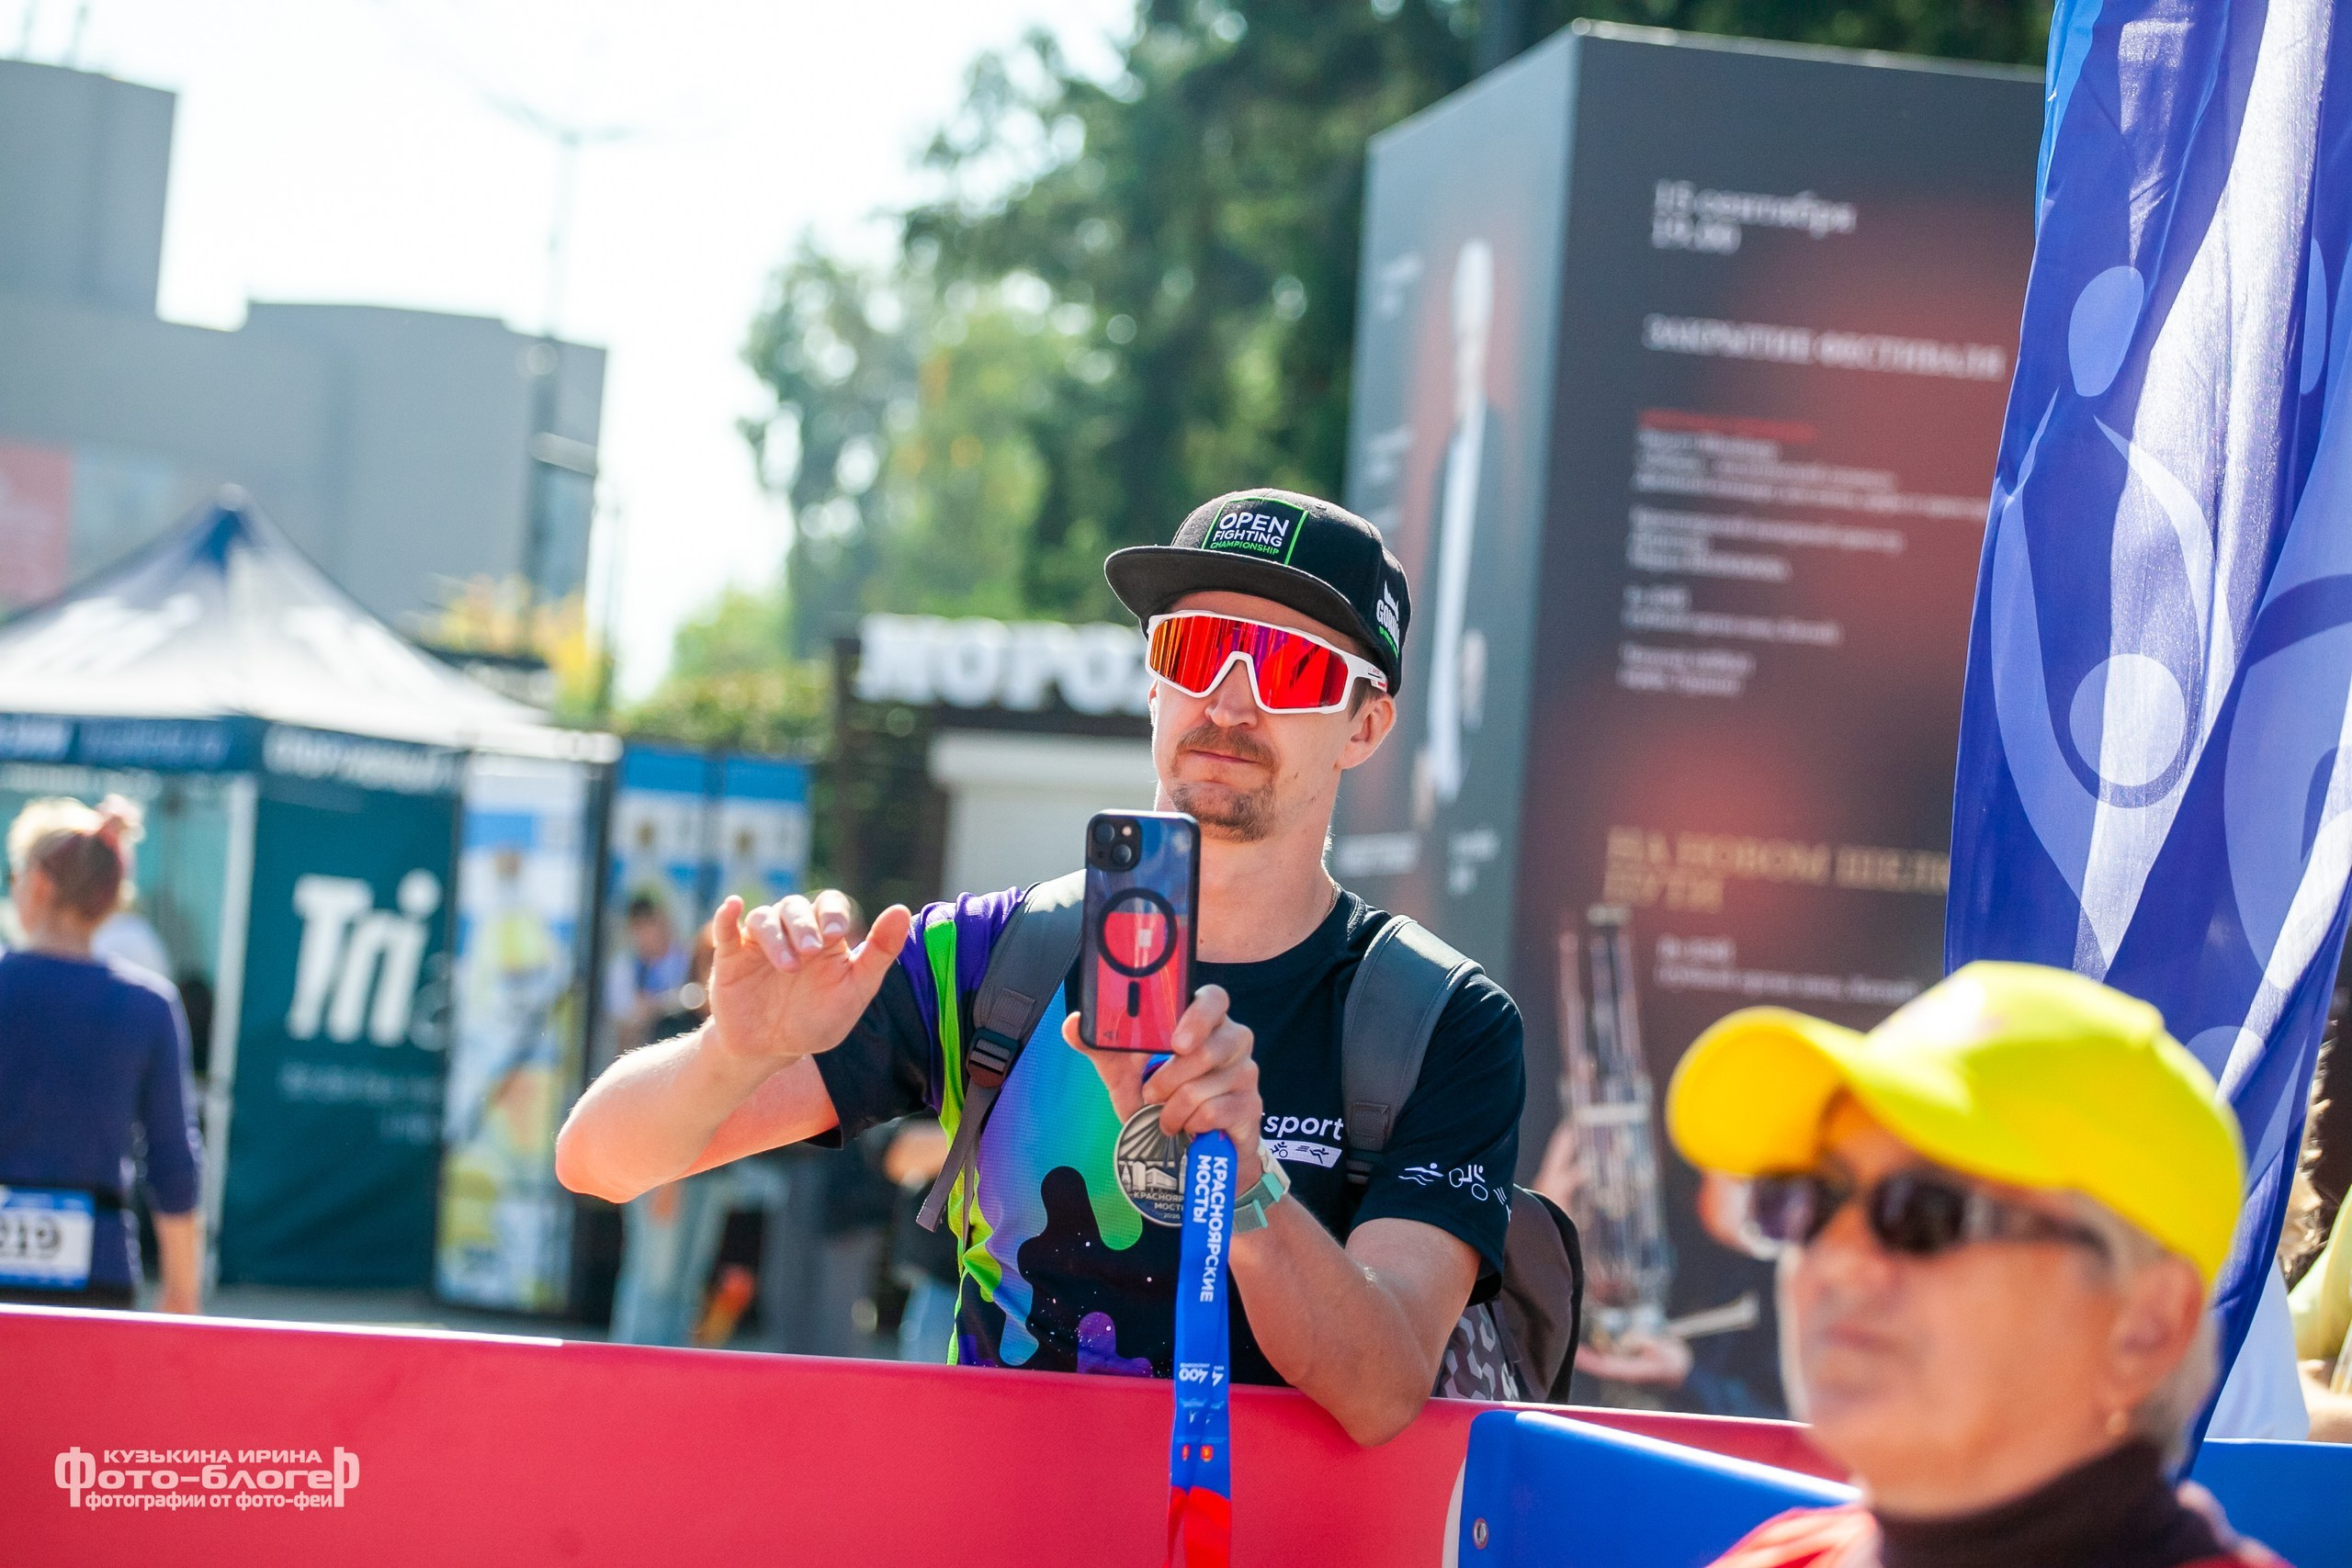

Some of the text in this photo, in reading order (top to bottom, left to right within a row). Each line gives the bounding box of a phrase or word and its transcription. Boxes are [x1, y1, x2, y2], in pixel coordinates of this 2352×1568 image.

[1219, 512, 1290, 537] OPEN
[1210, 540, 1280, 556] CHAMPIONSHIP
[1213, 529, 1283, 547] FIGHTING
[1262, 1112, 1344, 1141] sport
[1133, 1191, 1184, 1202] КРАСНОЯР
[1193, 1154, 1212, 1224] МОСТЫ
[1200, 1156, 1228, 1303] КРАСНОЯРСКИЕ
